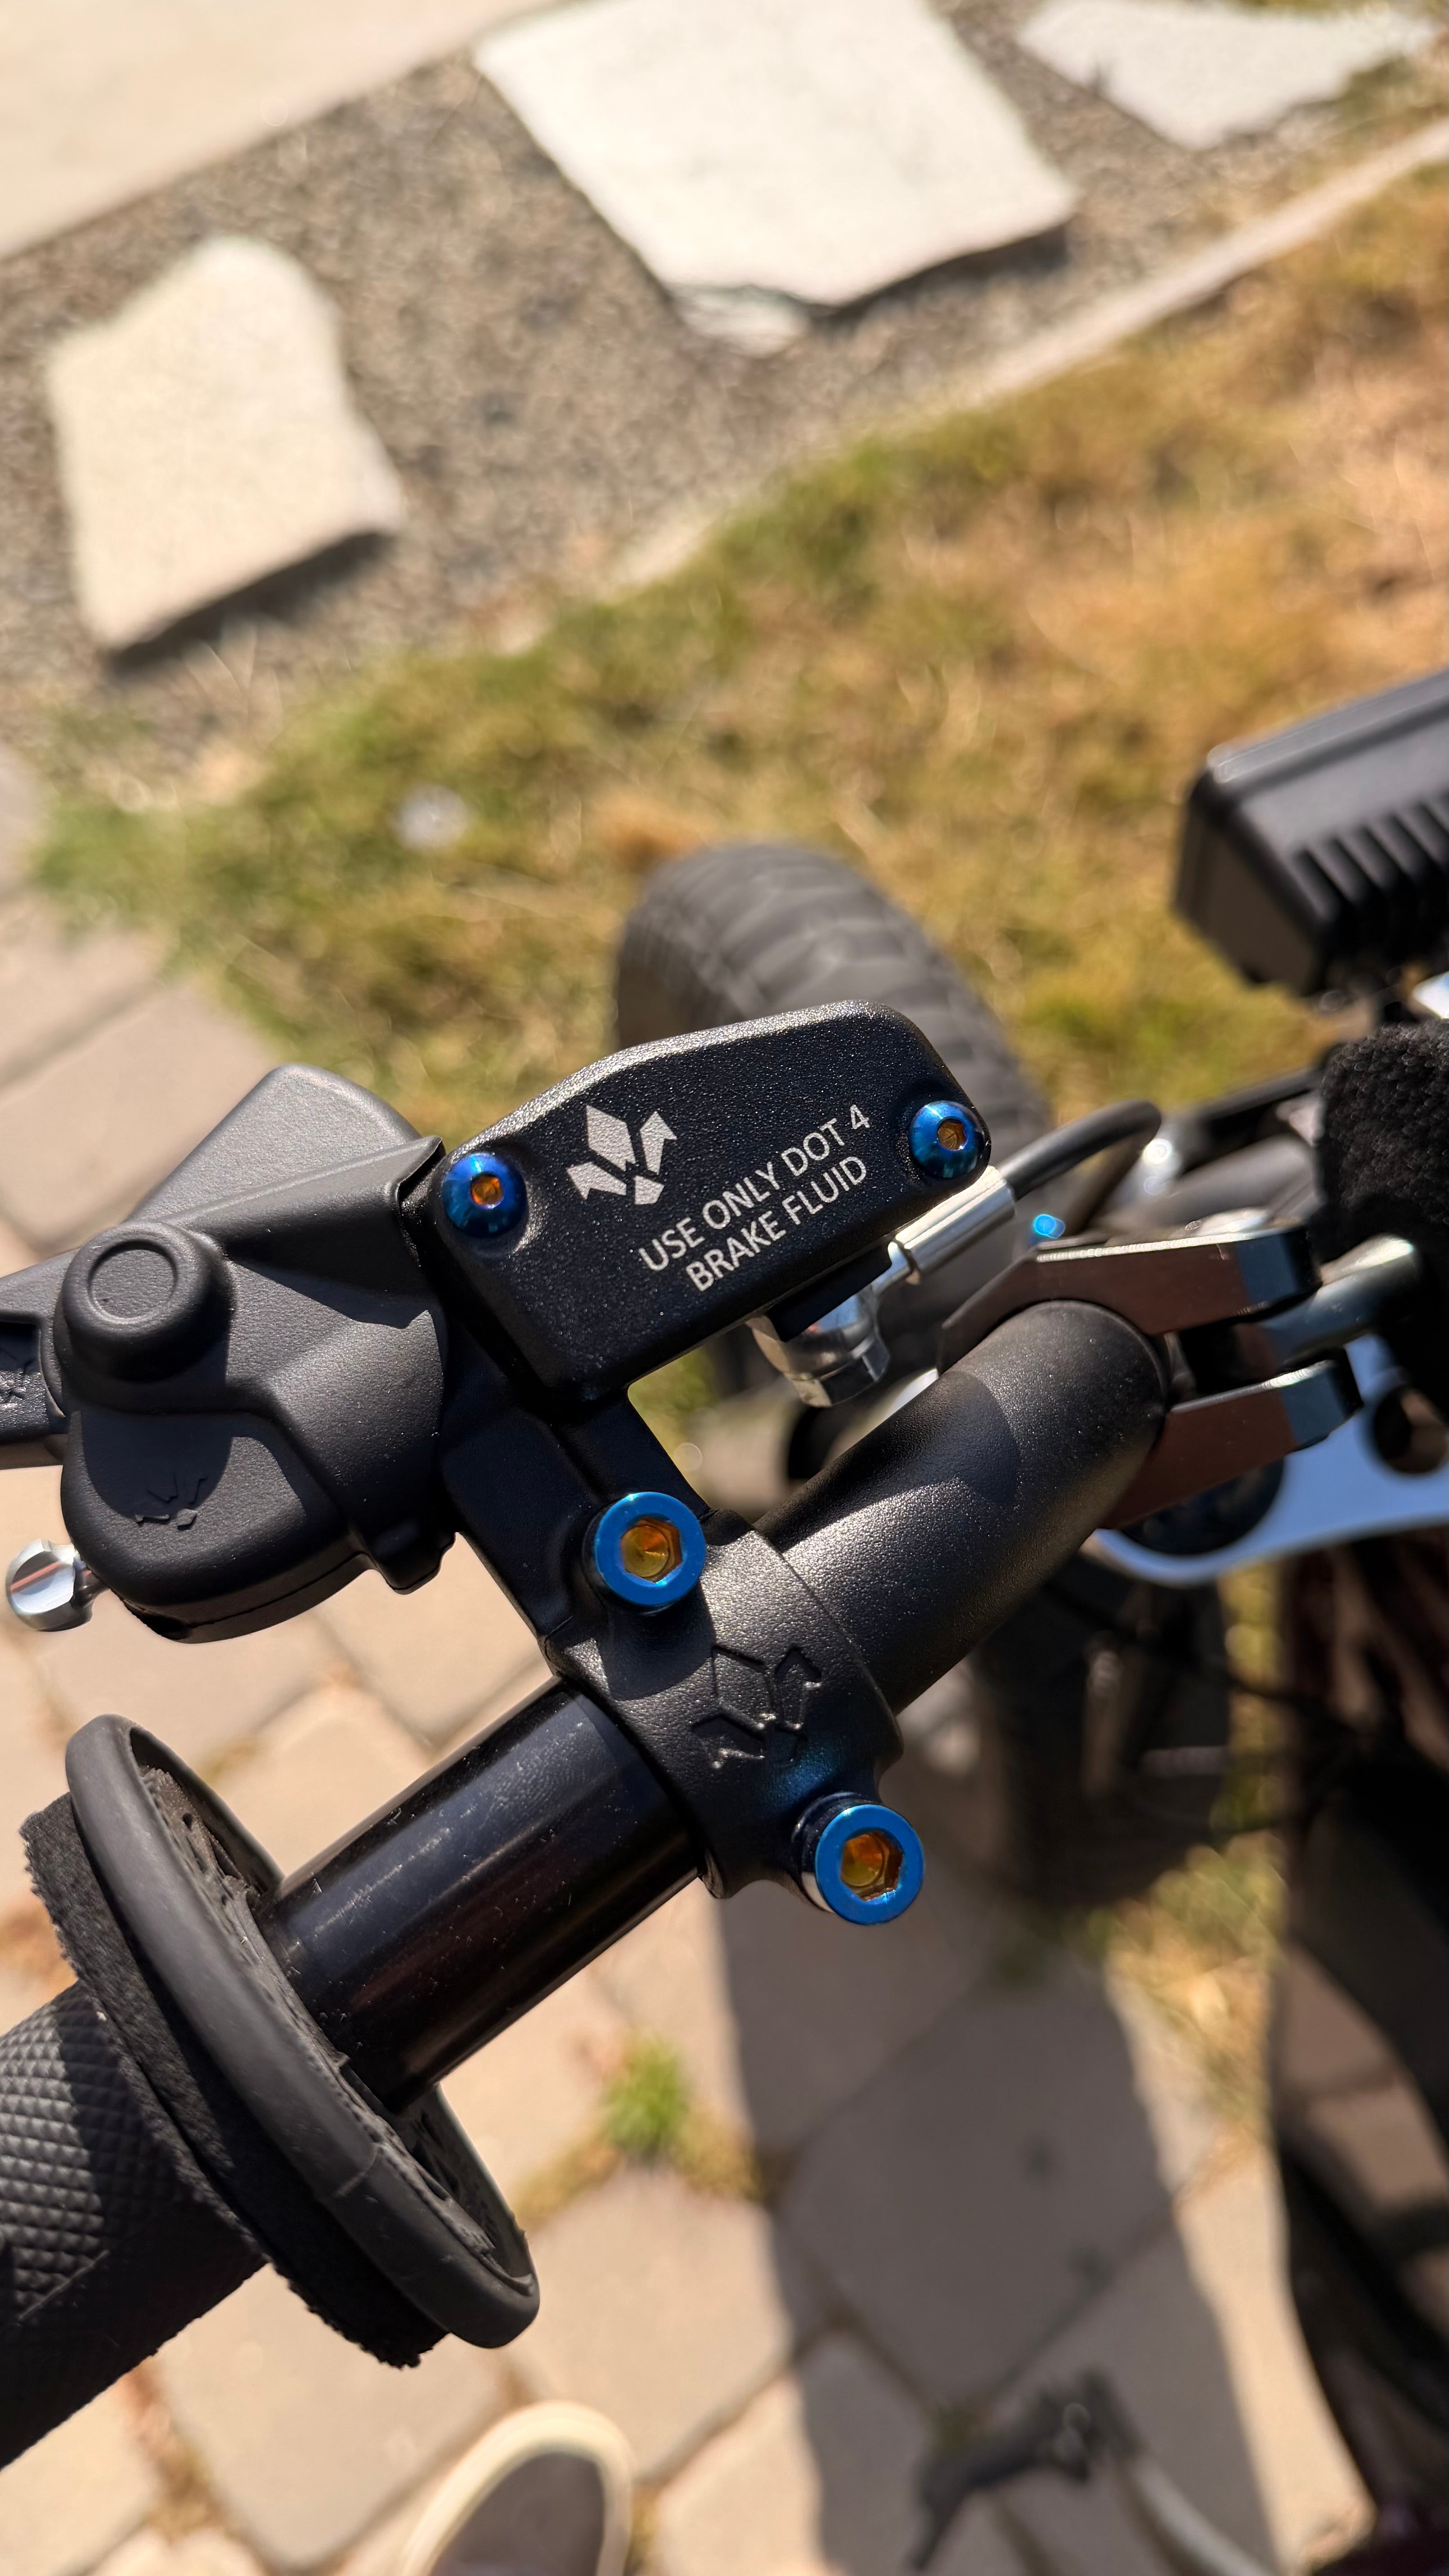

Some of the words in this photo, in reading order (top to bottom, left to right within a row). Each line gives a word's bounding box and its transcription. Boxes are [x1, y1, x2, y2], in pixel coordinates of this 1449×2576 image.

[639, 1218, 704, 1270] USE
[703, 1162, 780, 1229] ONLY
[781, 1118, 844, 1176] DOT
[850, 1104, 870, 1129] 4
[686, 1211, 787, 1292] BRAKE
[782, 1156, 867, 1225] FLUID
